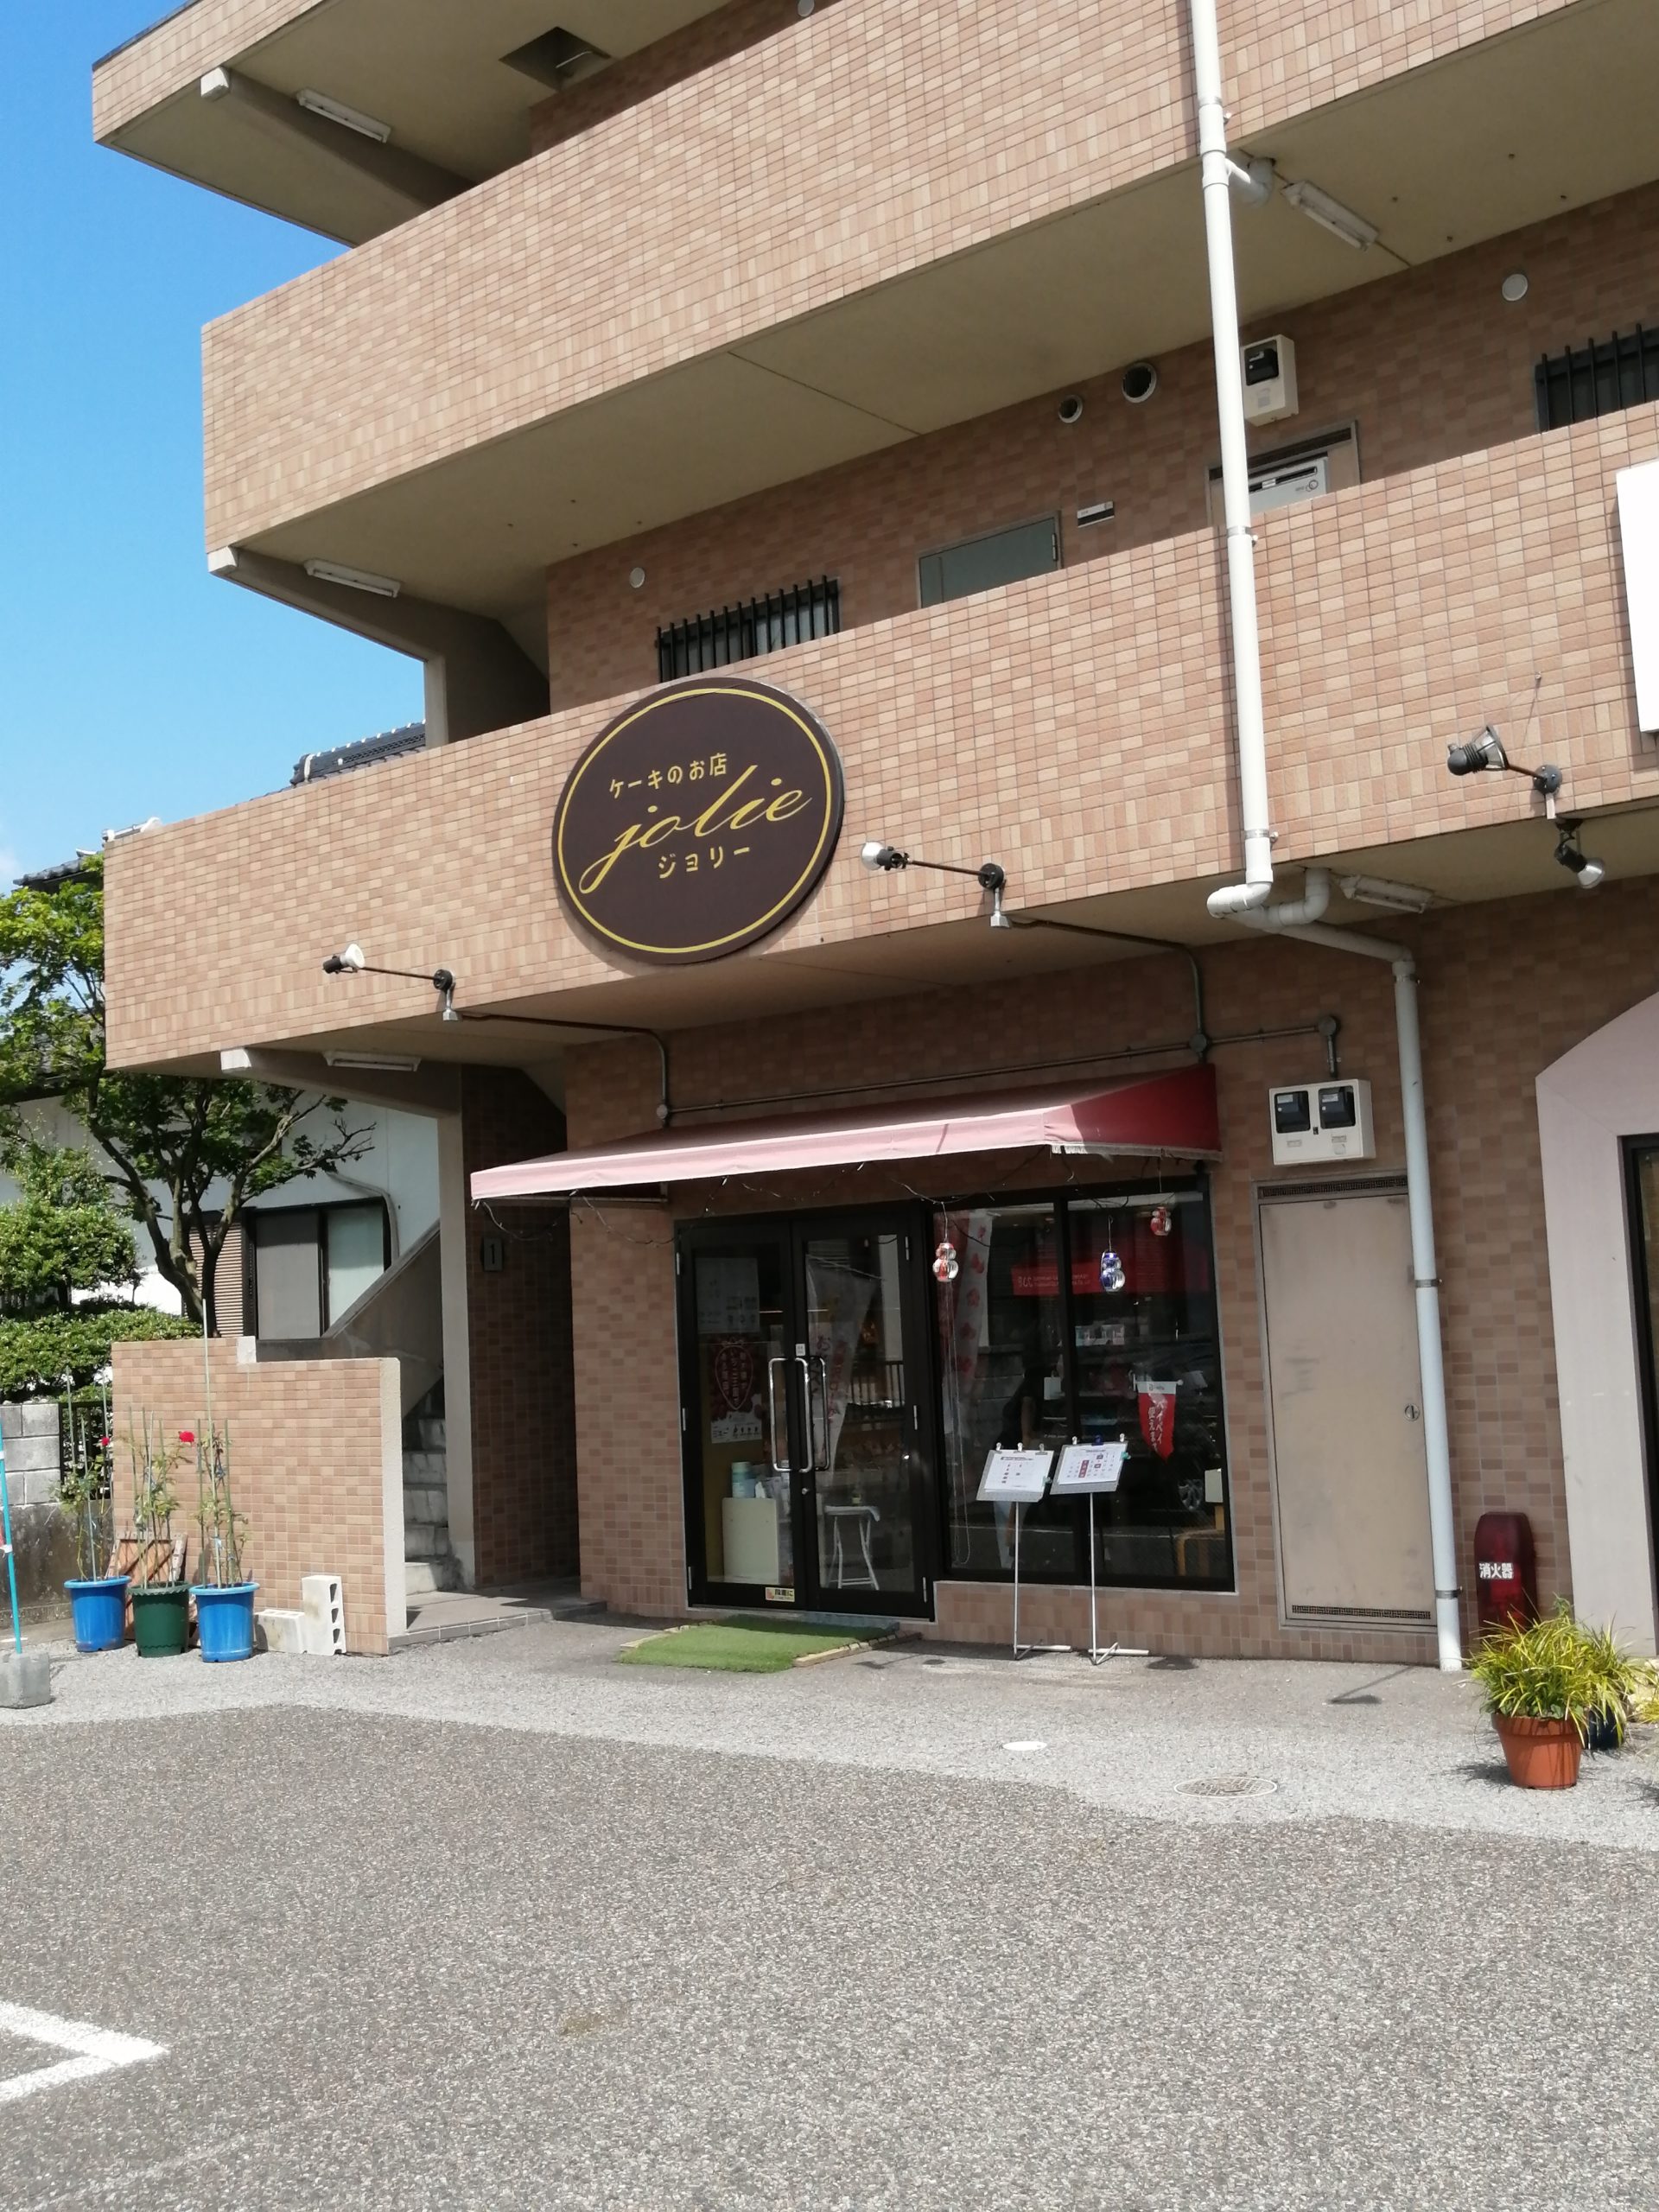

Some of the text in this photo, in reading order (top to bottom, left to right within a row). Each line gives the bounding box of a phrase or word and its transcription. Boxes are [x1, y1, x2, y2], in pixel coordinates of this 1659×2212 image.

[609, 753, 728, 799] ケーキのお店
[578, 765, 813, 894] jolie
[658, 846, 750, 880] ジョリー
[1478, 1562, 1514, 1580] 消火器
